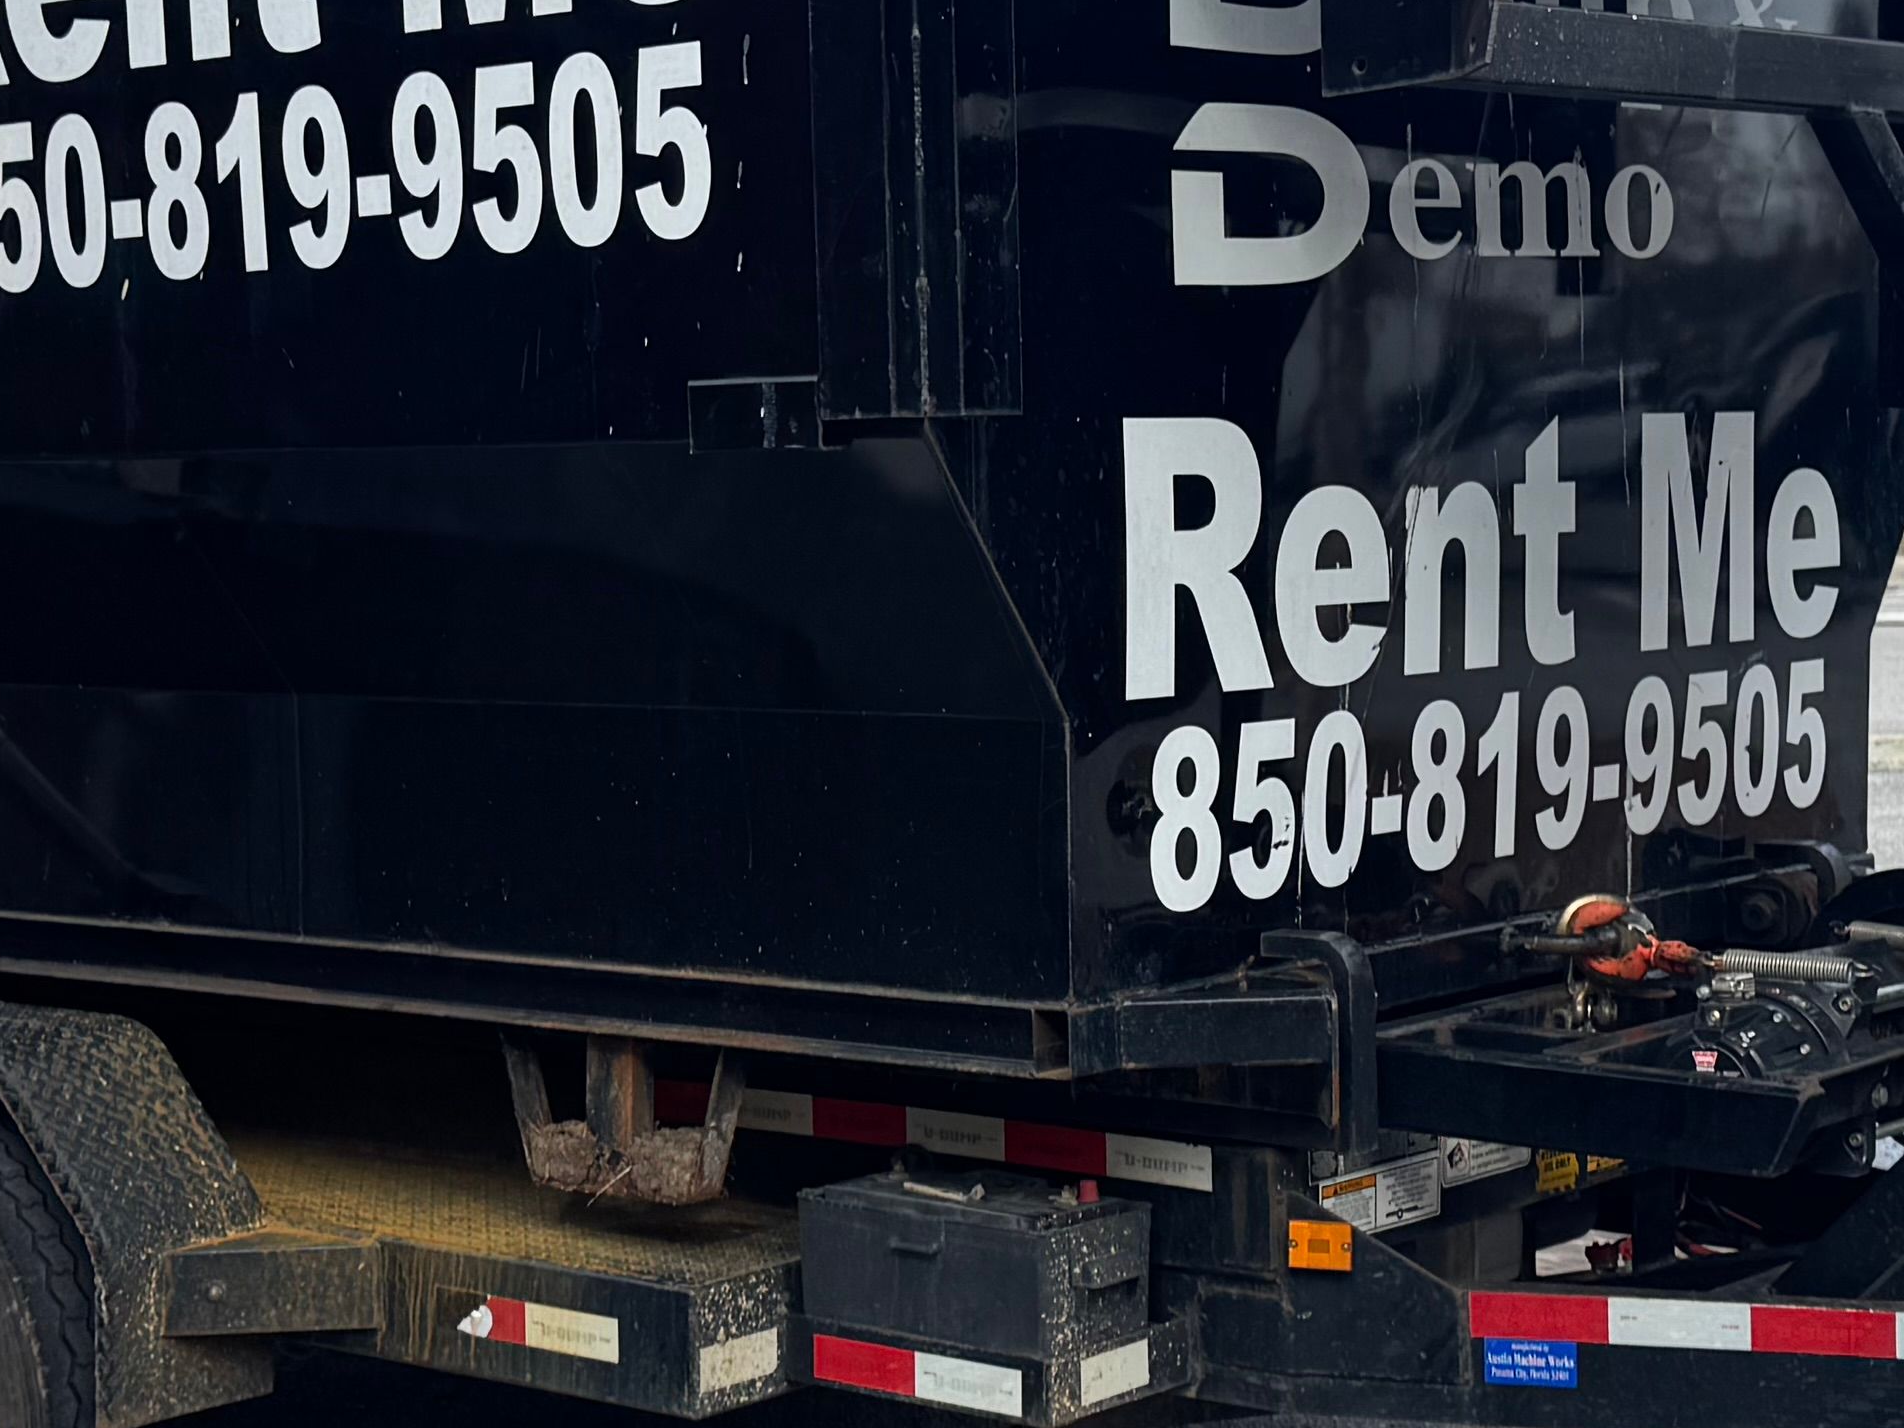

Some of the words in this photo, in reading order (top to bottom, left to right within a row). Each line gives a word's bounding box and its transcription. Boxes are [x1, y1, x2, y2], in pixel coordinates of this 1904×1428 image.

[1170, 101, 1676, 287] Demo
[1122, 414, 1577, 701] Rent
[1639, 410, 1842, 653] Me
[1149, 658, 1828, 914] 850-819-9505
[1487, 1351, 1513, 1365] Austin
[1514, 1352, 1547, 1368] Machine
[1547, 1354, 1575, 1369] Works
